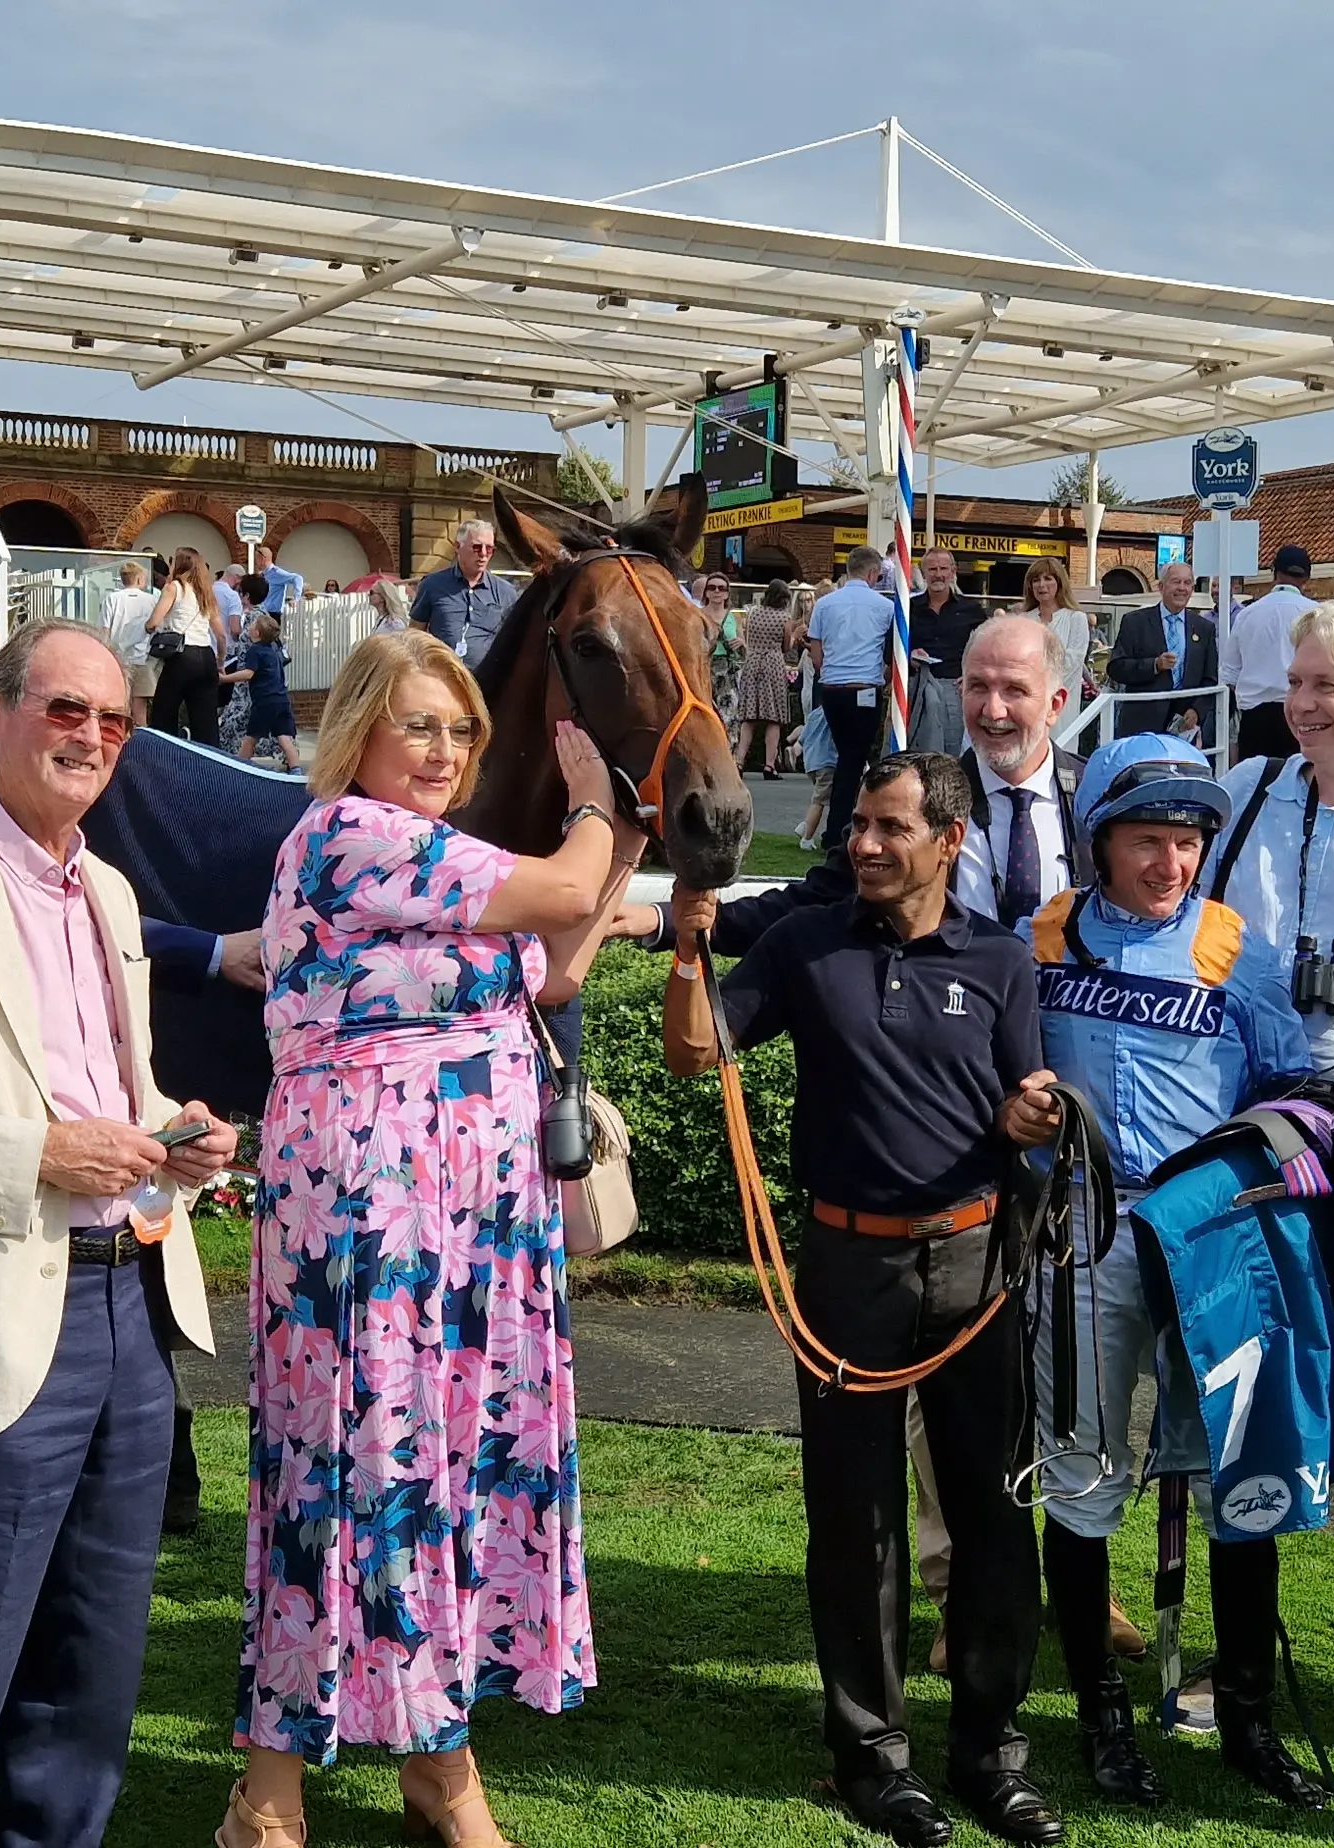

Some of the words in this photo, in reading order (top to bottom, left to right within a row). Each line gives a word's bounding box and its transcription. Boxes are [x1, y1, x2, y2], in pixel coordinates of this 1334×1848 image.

[1199, 457, 1250, 478] York
[708, 513, 736, 530] FLYING
[913, 533, 959, 549] FLING
[1039, 968, 1221, 1034] Tattersalls
[1203, 1336, 1262, 1472] 7
